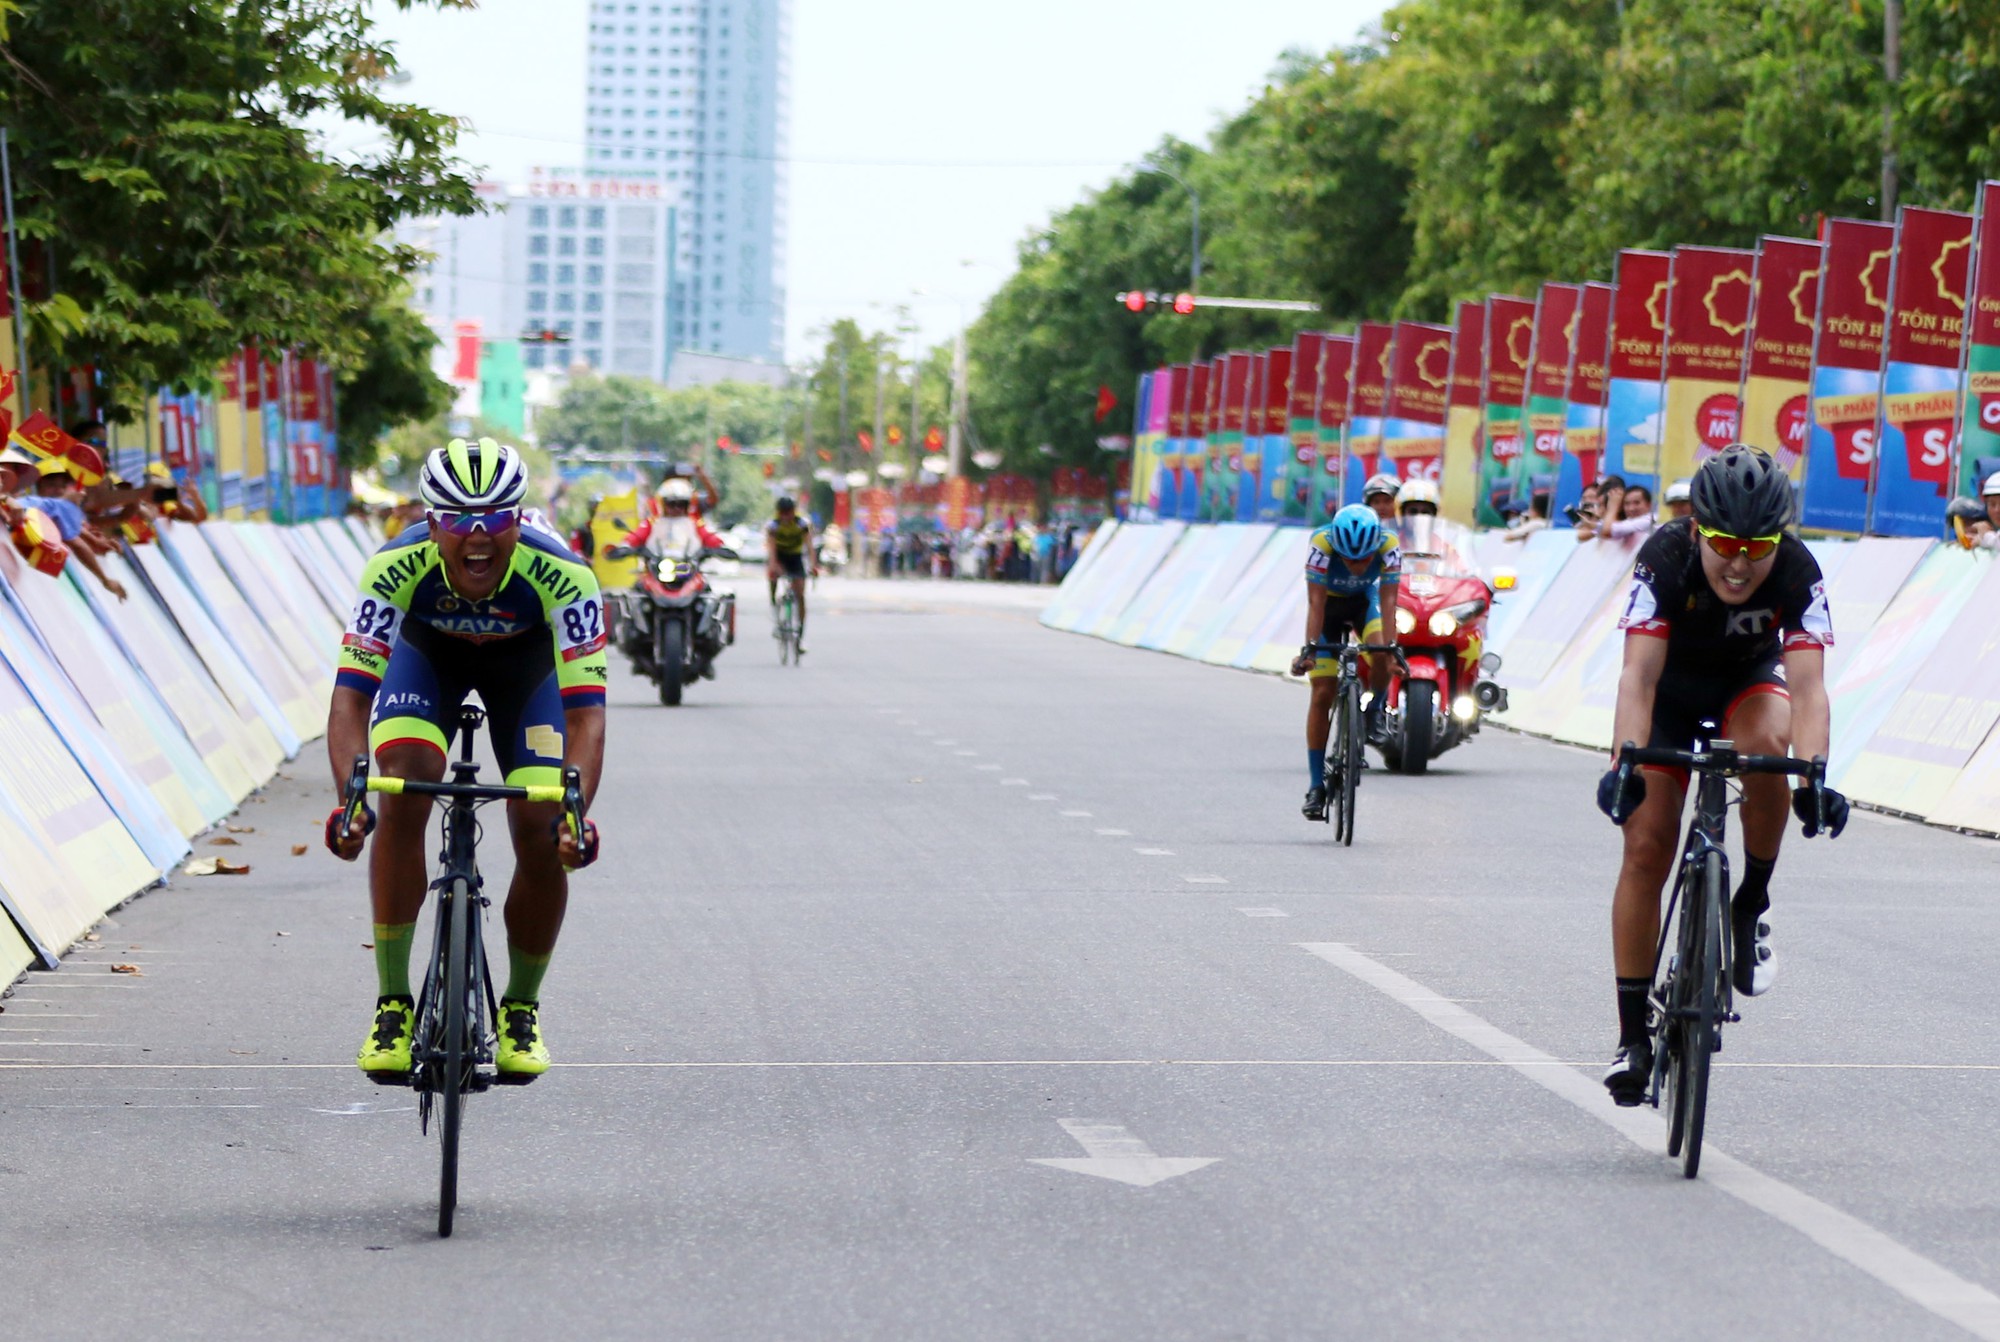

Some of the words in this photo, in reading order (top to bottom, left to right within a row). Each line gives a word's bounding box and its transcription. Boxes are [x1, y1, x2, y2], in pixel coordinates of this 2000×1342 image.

[1827, 314, 1865, 335] TÔN
[1898, 308, 1937, 330] TÔN
[371, 547, 427, 601] NAVY
[527, 555, 583, 606] NAVY
[356, 599, 396, 644] 82
[431, 618, 517, 634] NAVY
[562, 599, 600, 644] 82
